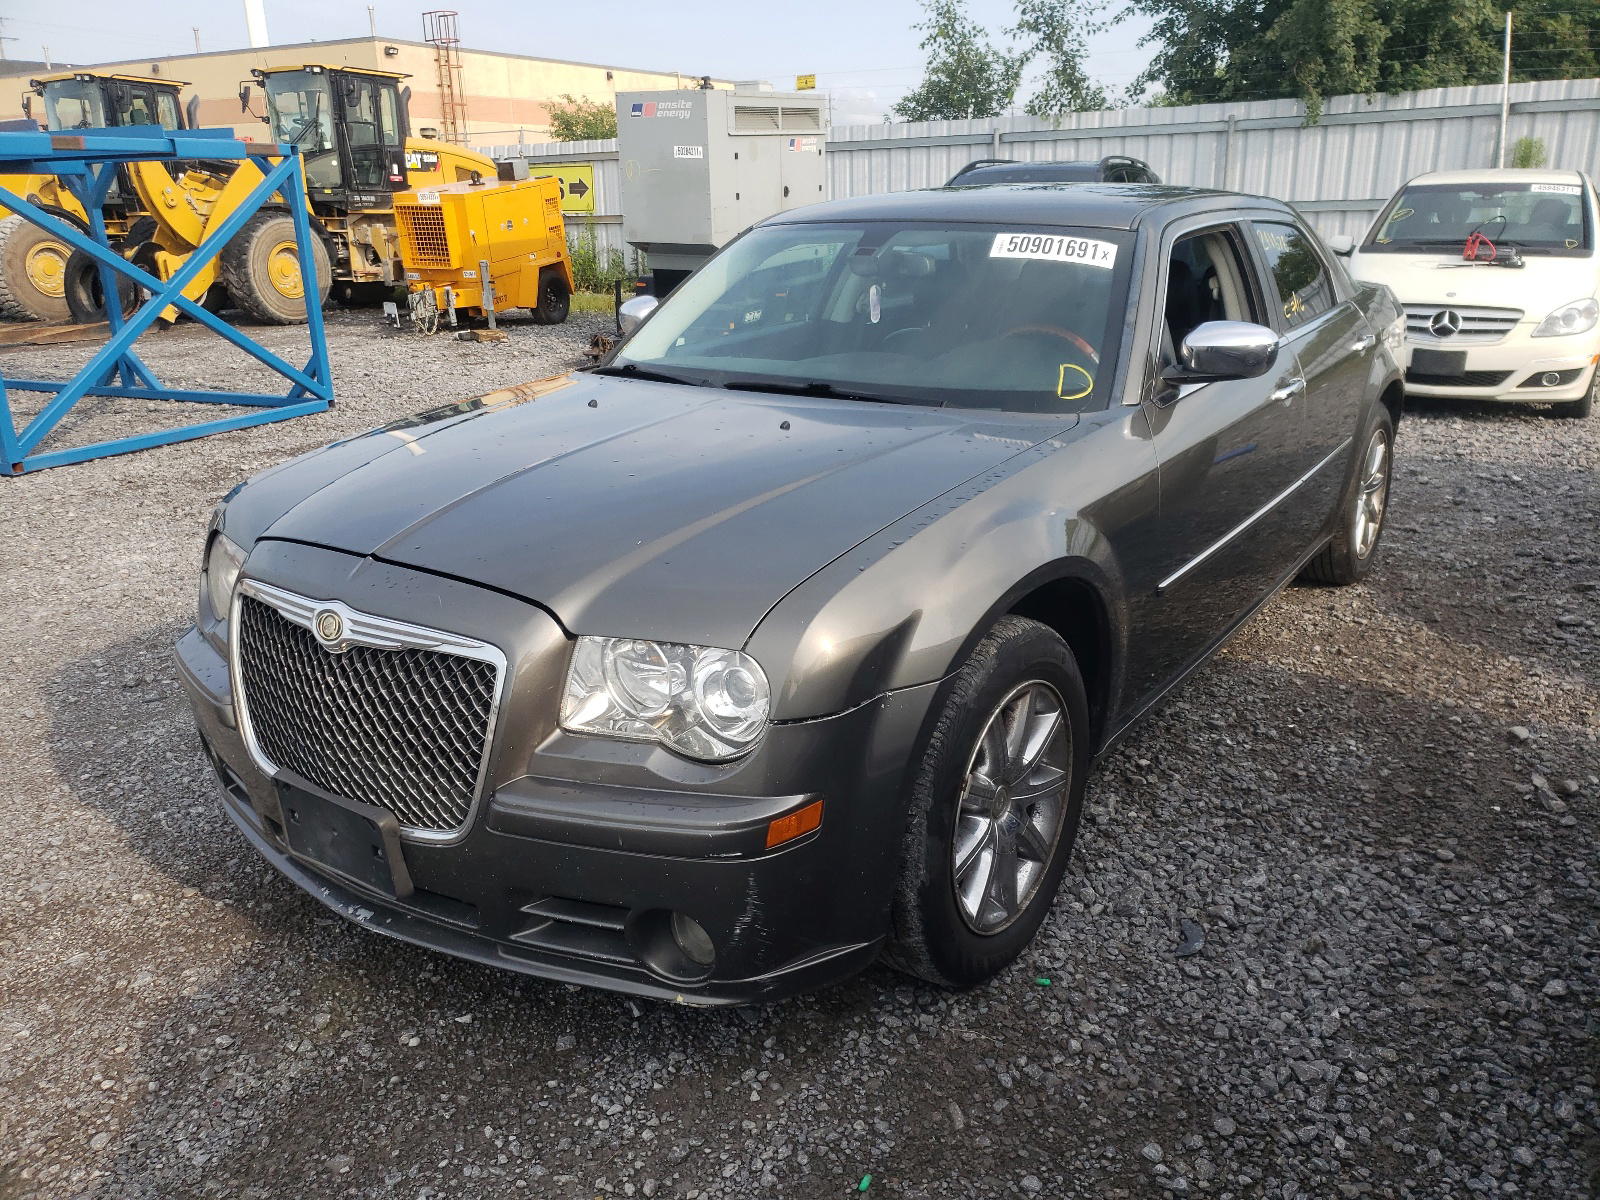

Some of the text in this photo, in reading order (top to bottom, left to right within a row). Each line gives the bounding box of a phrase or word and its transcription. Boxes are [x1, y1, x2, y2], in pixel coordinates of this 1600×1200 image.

[658, 100, 693, 109] onsite
[656, 110, 692, 119] energy
[405, 153, 421, 169] CAT
[1057, 363, 1094, 399] D
